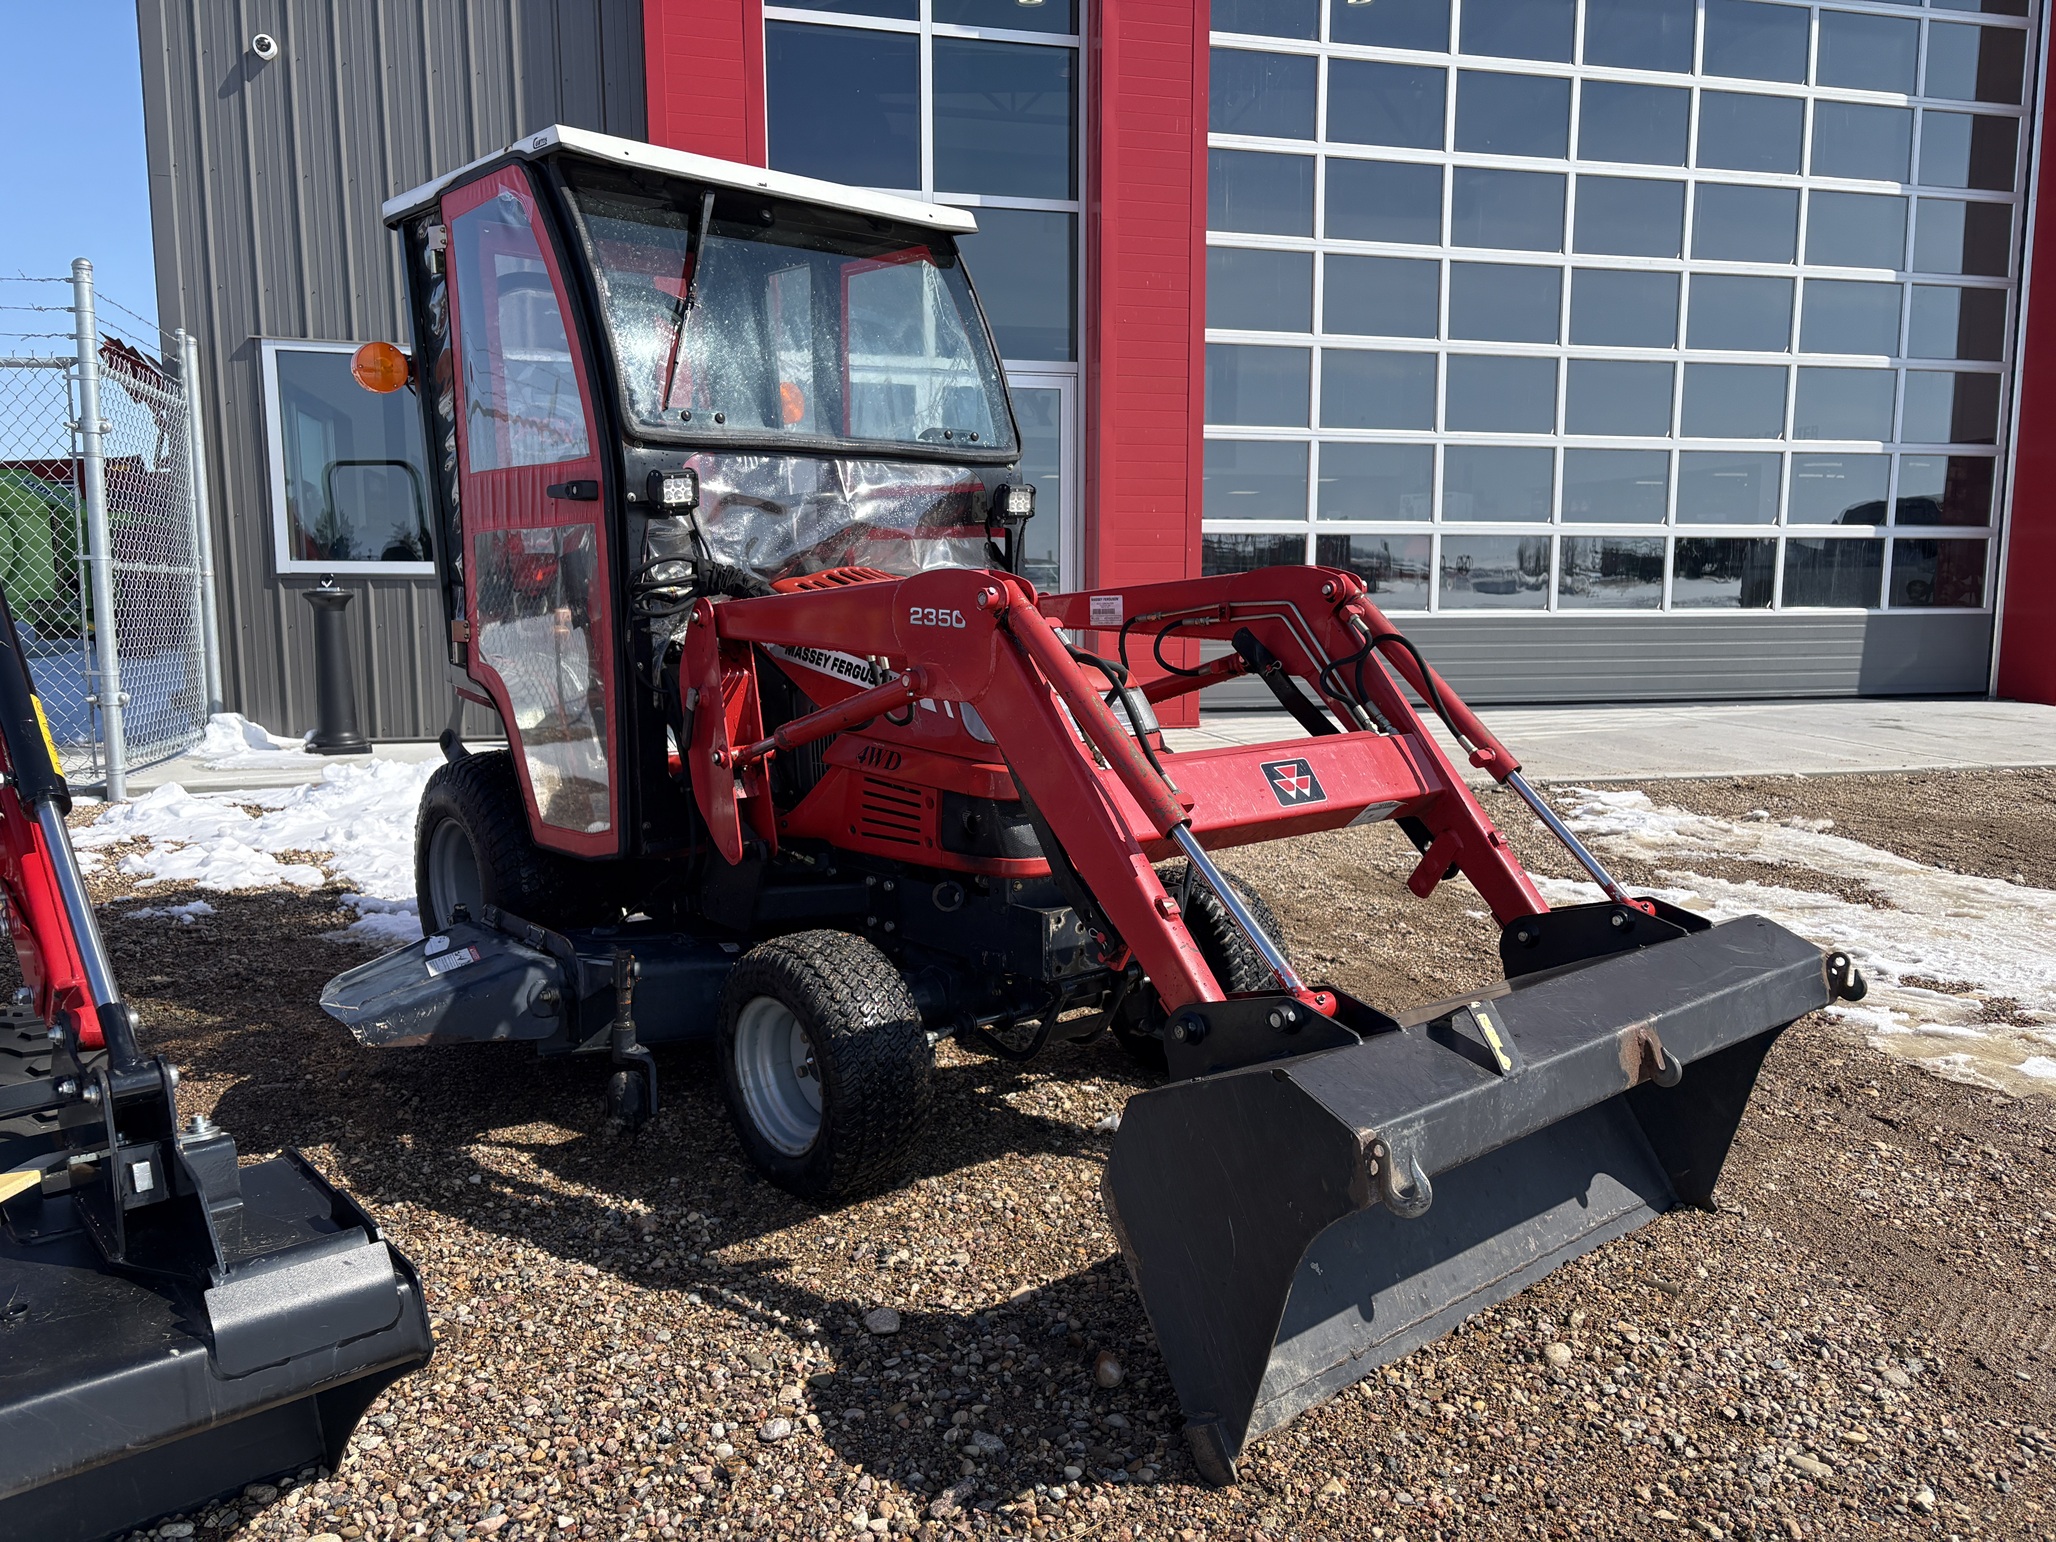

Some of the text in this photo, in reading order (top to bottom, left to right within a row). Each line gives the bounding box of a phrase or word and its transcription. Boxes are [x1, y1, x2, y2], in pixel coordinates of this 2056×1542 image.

[910, 607, 966, 628] 2350
[784, 646, 897, 685] MASSEY FERGUS
[856, 745, 902, 771] 4WD
